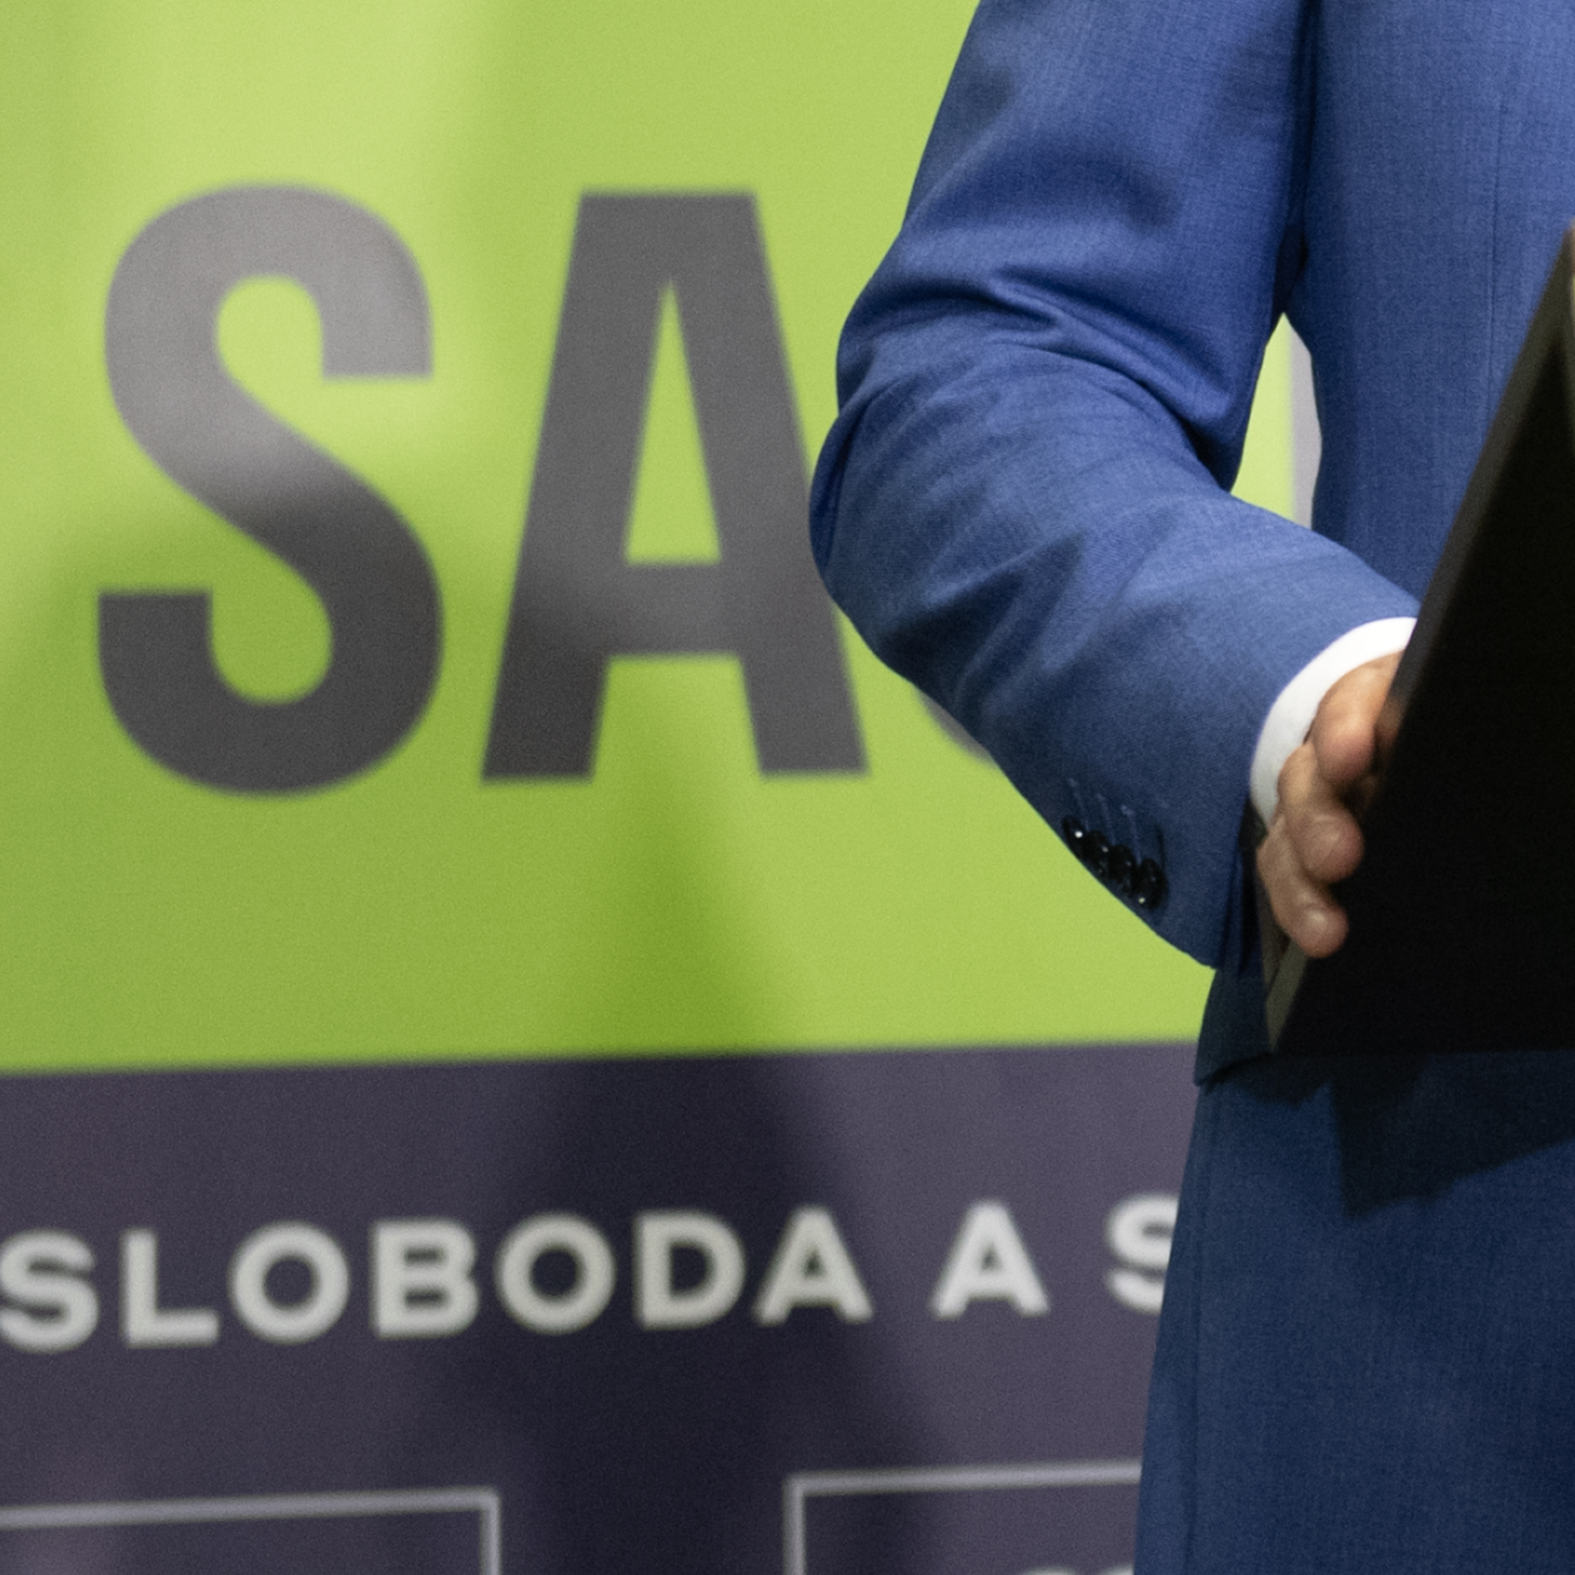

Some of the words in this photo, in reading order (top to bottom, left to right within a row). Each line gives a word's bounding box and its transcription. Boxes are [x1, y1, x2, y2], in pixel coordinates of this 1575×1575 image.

[97, 180, 1010, 798] SA
[0, 1209, 872, 1353] SLOBODA
[929, 1199, 1051, 1319] A
